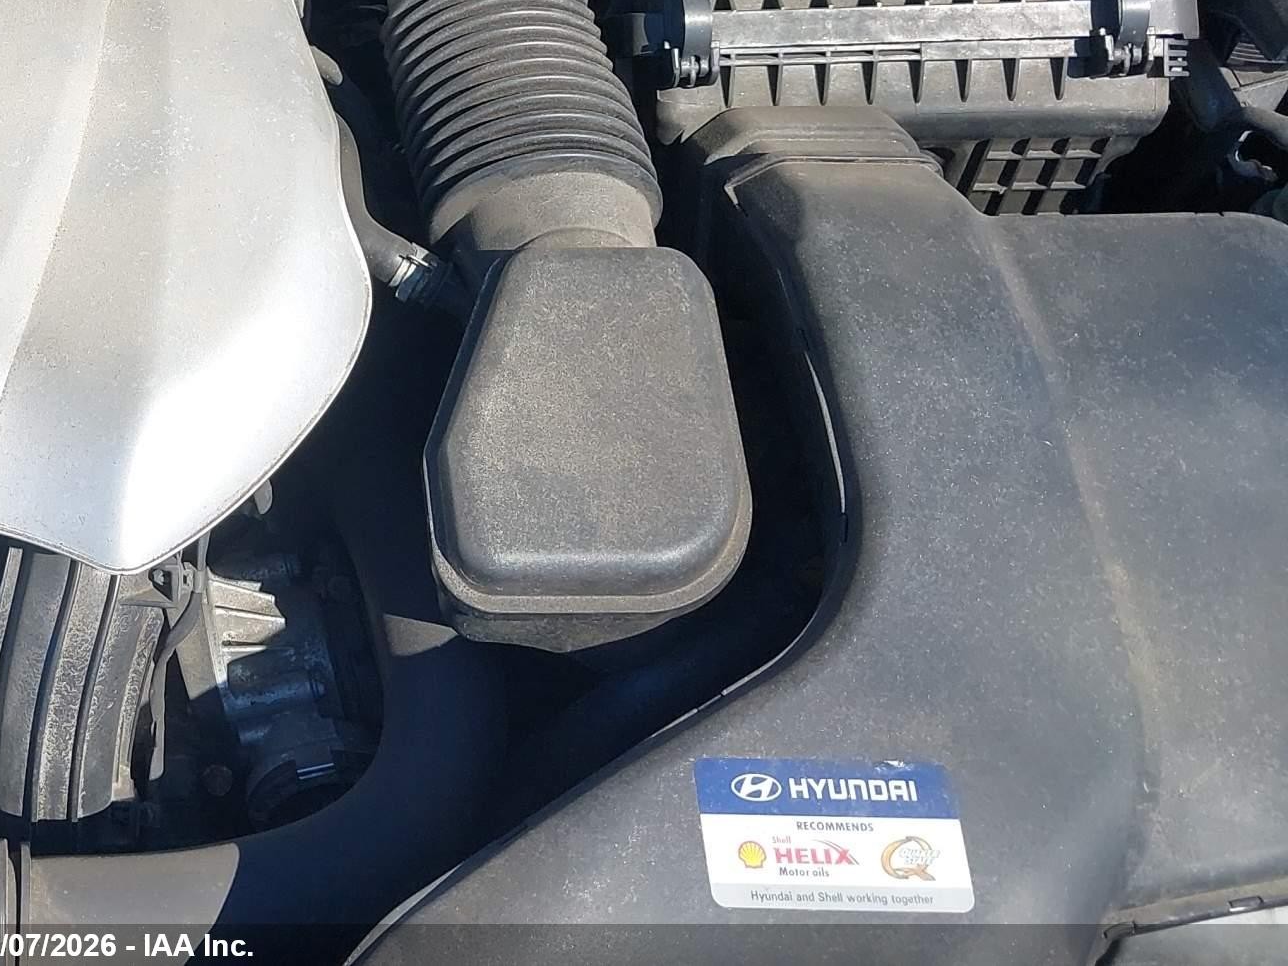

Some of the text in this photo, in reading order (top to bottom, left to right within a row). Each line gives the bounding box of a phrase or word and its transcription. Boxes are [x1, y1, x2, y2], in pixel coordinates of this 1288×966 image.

[789, 777, 918, 802] HYUNDAI
[796, 821, 874, 832] RECOMMENDS
[772, 836, 792, 845] Shell
[773, 847, 856, 865] HELIX
[779, 867, 830, 878] Motor oils
[750, 890, 934, 906] Hyundai and Shell working together
